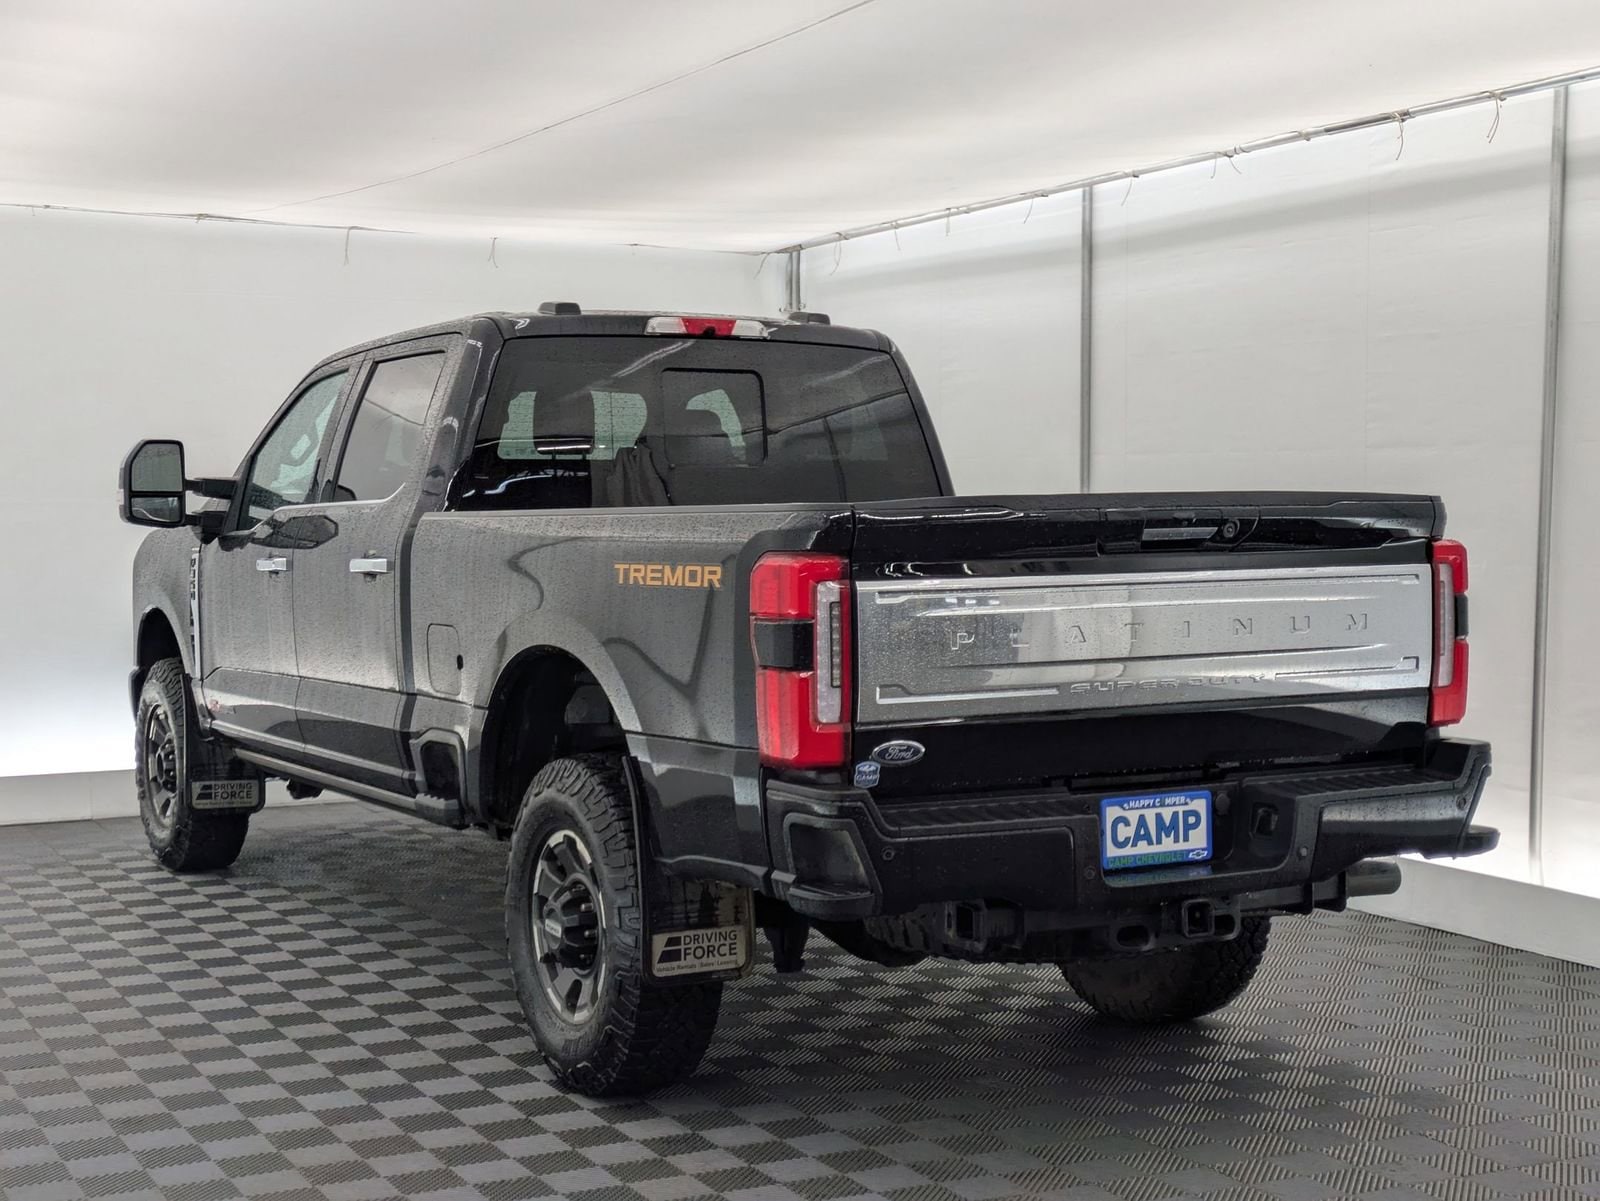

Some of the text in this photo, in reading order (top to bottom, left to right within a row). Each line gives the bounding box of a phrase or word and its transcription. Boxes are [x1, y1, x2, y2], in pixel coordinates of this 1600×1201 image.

[614, 562, 722, 588] TREMOR
[950, 613, 1368, 650] PLATINUM
[1070, 673, 1266, 694] SUPER DUTY
[213, 783, 253, 791] DRIVING
[213, 790, 253, 800] FORCE
[1129, 796, 1186, 809] HAPPY CMPER
[1111, 809, 1202, 849] CAMP
[1108, 851, 1187, 867] CAMP CHEVROLET
[683, 929, 737, 946] DRIVING
[683, 942, 737, 961] FORCE
